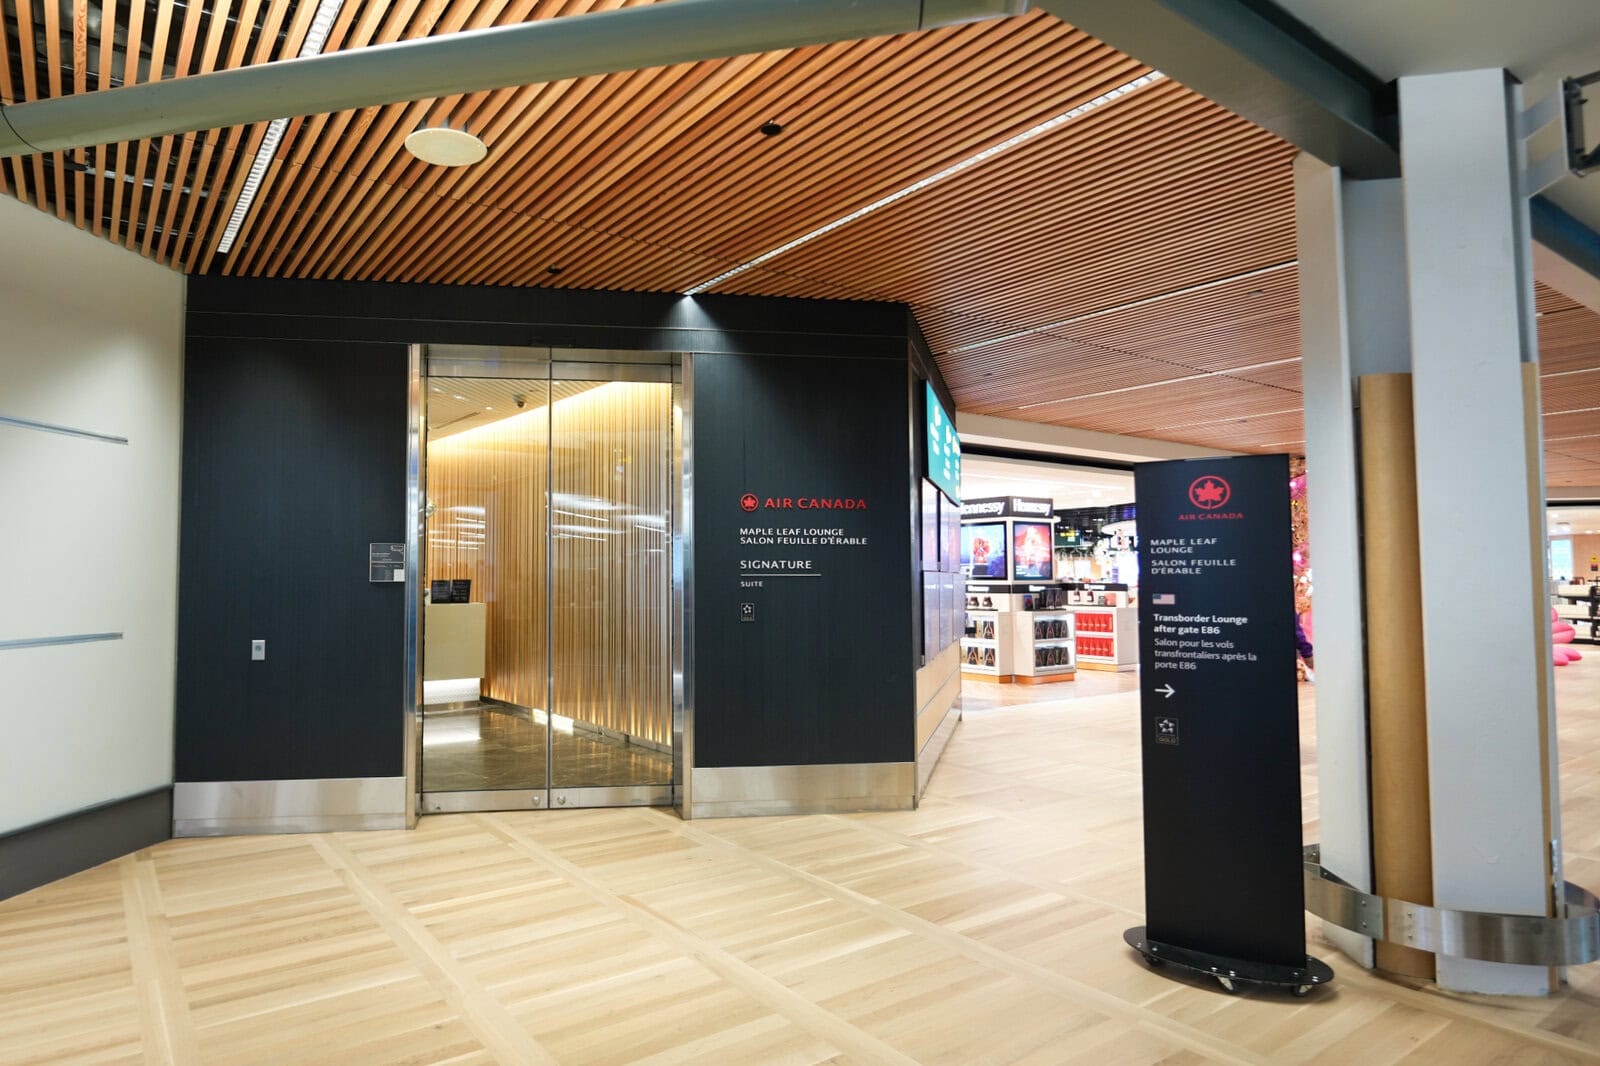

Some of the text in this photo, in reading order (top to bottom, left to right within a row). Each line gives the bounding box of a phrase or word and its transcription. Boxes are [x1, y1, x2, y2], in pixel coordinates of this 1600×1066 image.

[765, 498, 867, 509] AIR CANADA
[960, 499, 1005, 515] ennessy
[1198, 512, 1244, 520] CANADA
[739, 528, 774, 536] MAPLE
[740, 536, 868, 545] SALON FEUILLE D'ÉRABLE
[740, 560, 812, 569] SIGNATURE
[1151, 567, 1202, 575] D'ÉRABLE
[1153, 614, 1248, 626] Transborder Lounge
[1178, 627, 1199, 635] gate
[1154, 638, 1234, 649] Salon pour les vols
[1154, 650, 1258, 662] transfrontaliers après la
[1154, 661, 1197, 670] porte E86
